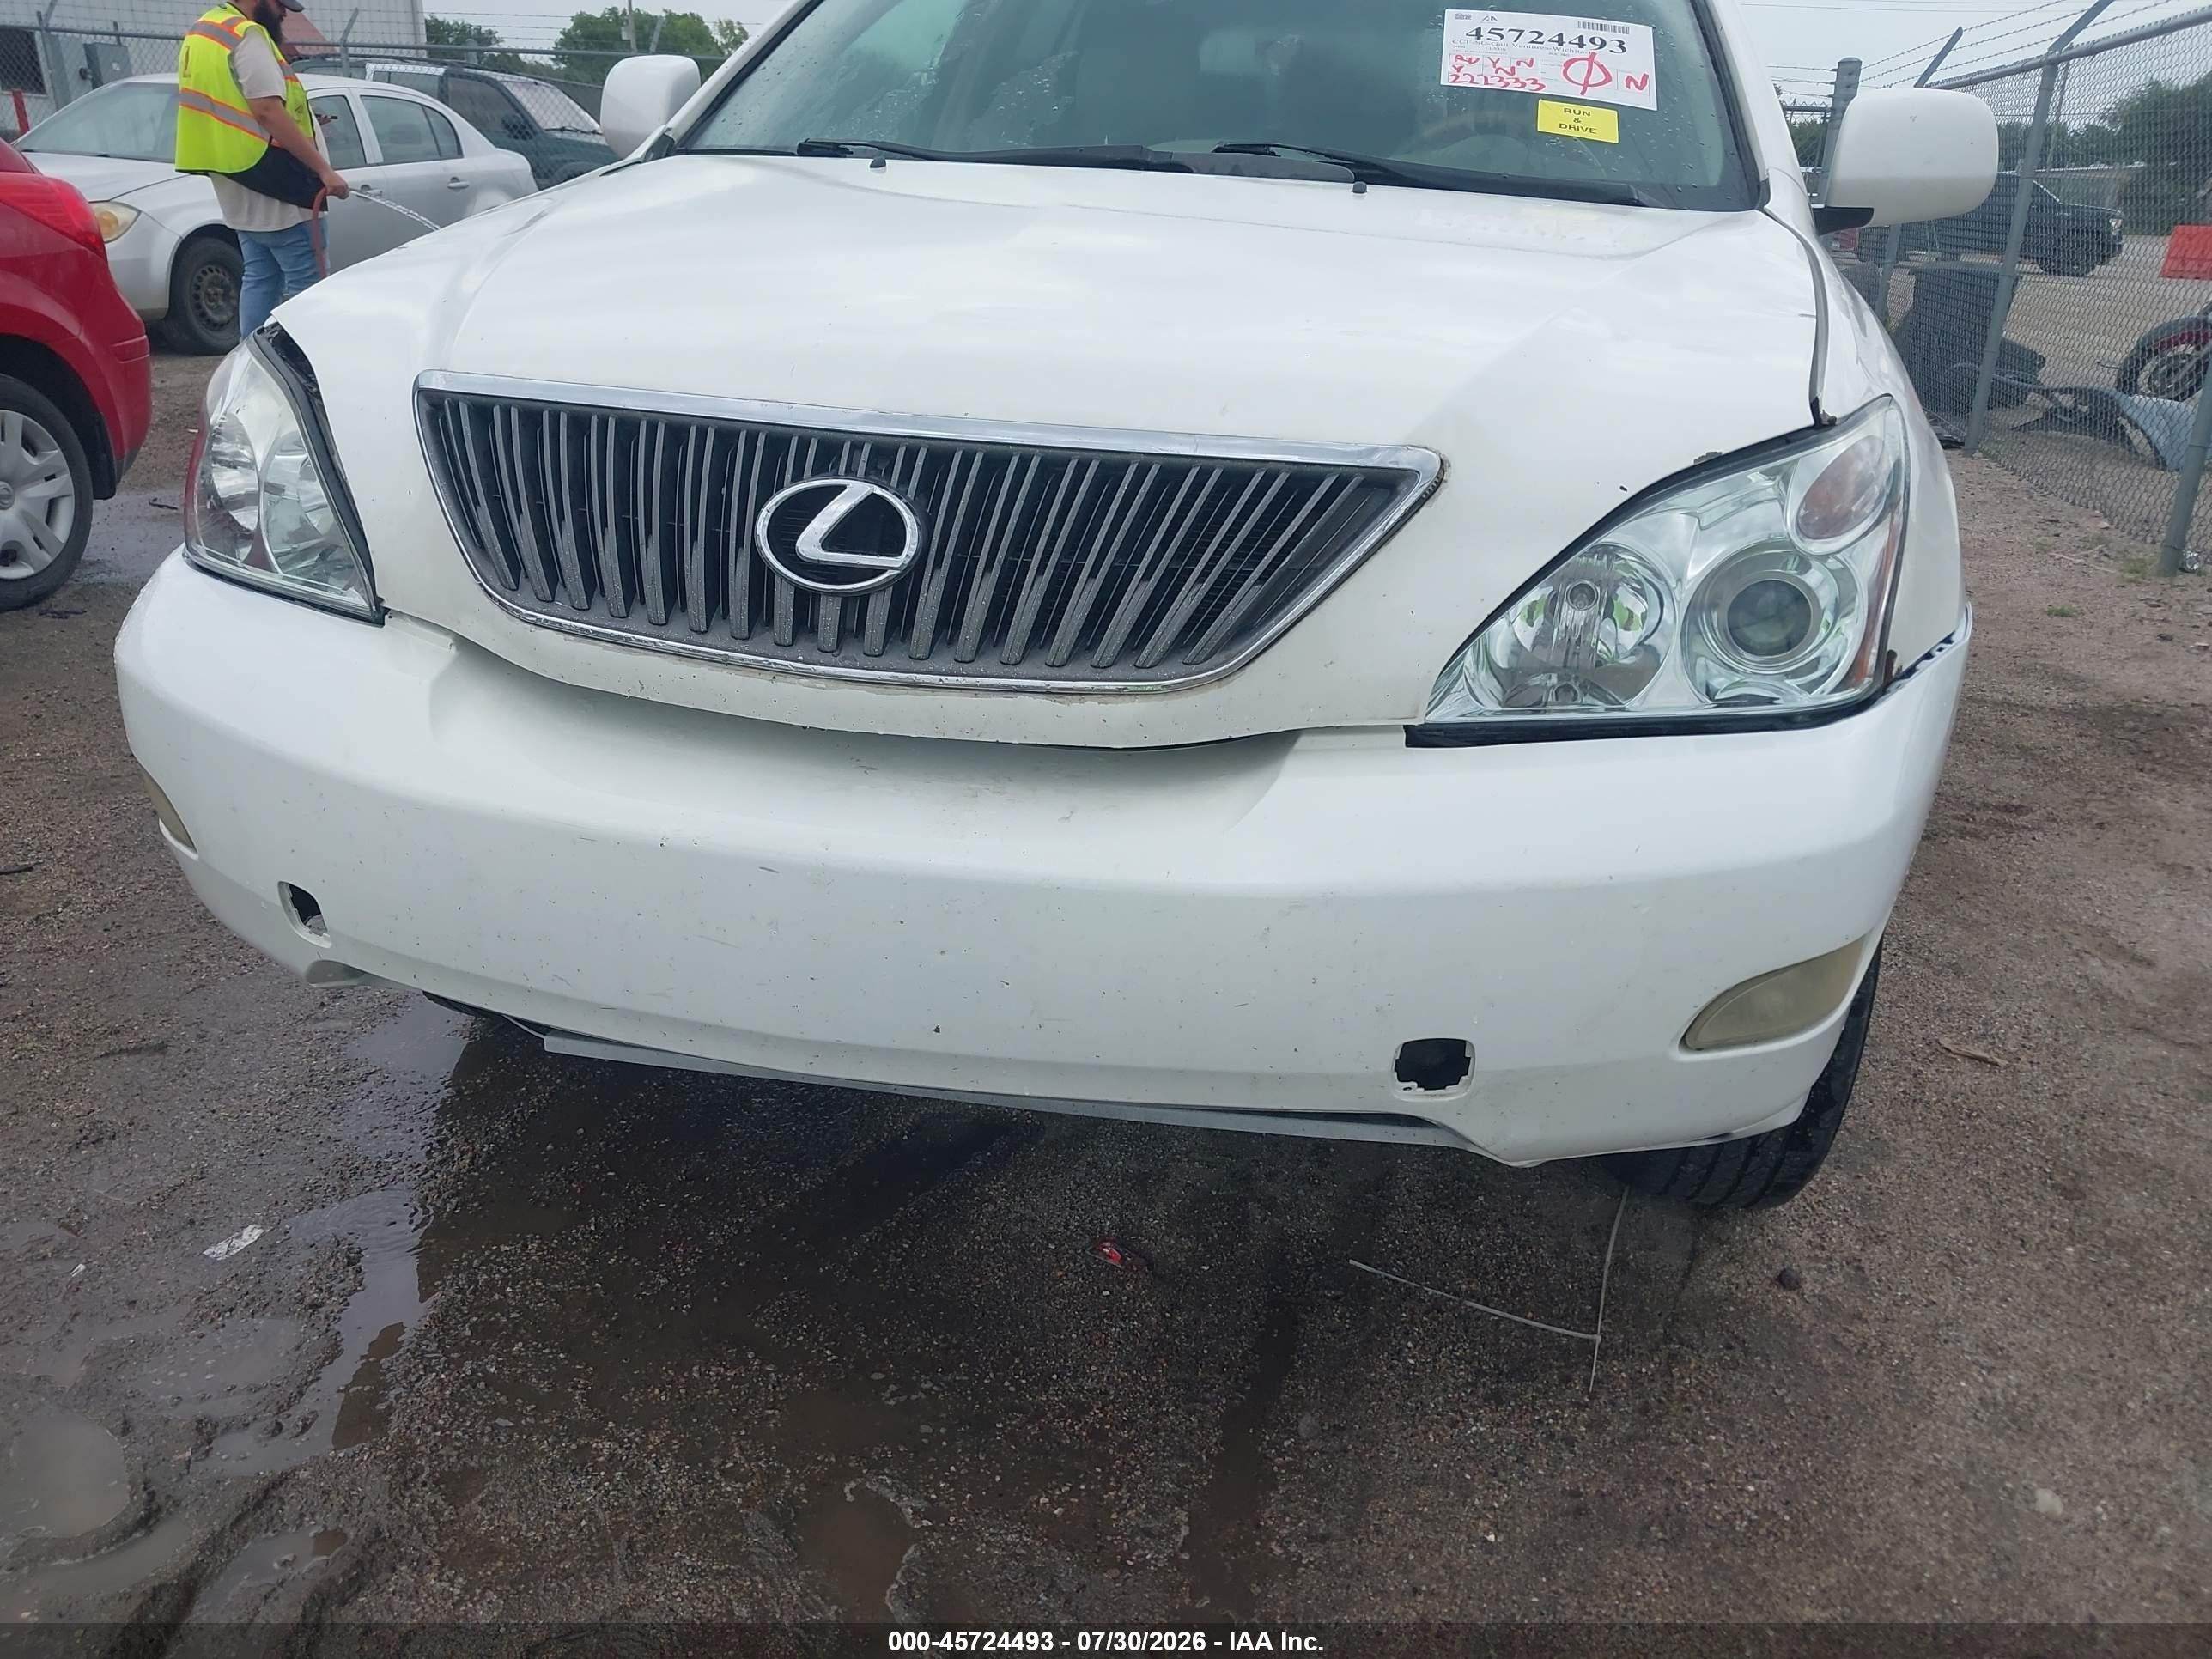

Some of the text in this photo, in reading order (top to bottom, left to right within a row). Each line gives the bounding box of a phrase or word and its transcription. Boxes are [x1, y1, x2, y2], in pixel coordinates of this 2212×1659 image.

[1465, 27, 1627, 54] 45724493
[1563, 107, 1591, 118] RUN
[1559, 123, 1598, 135] DRIVE
